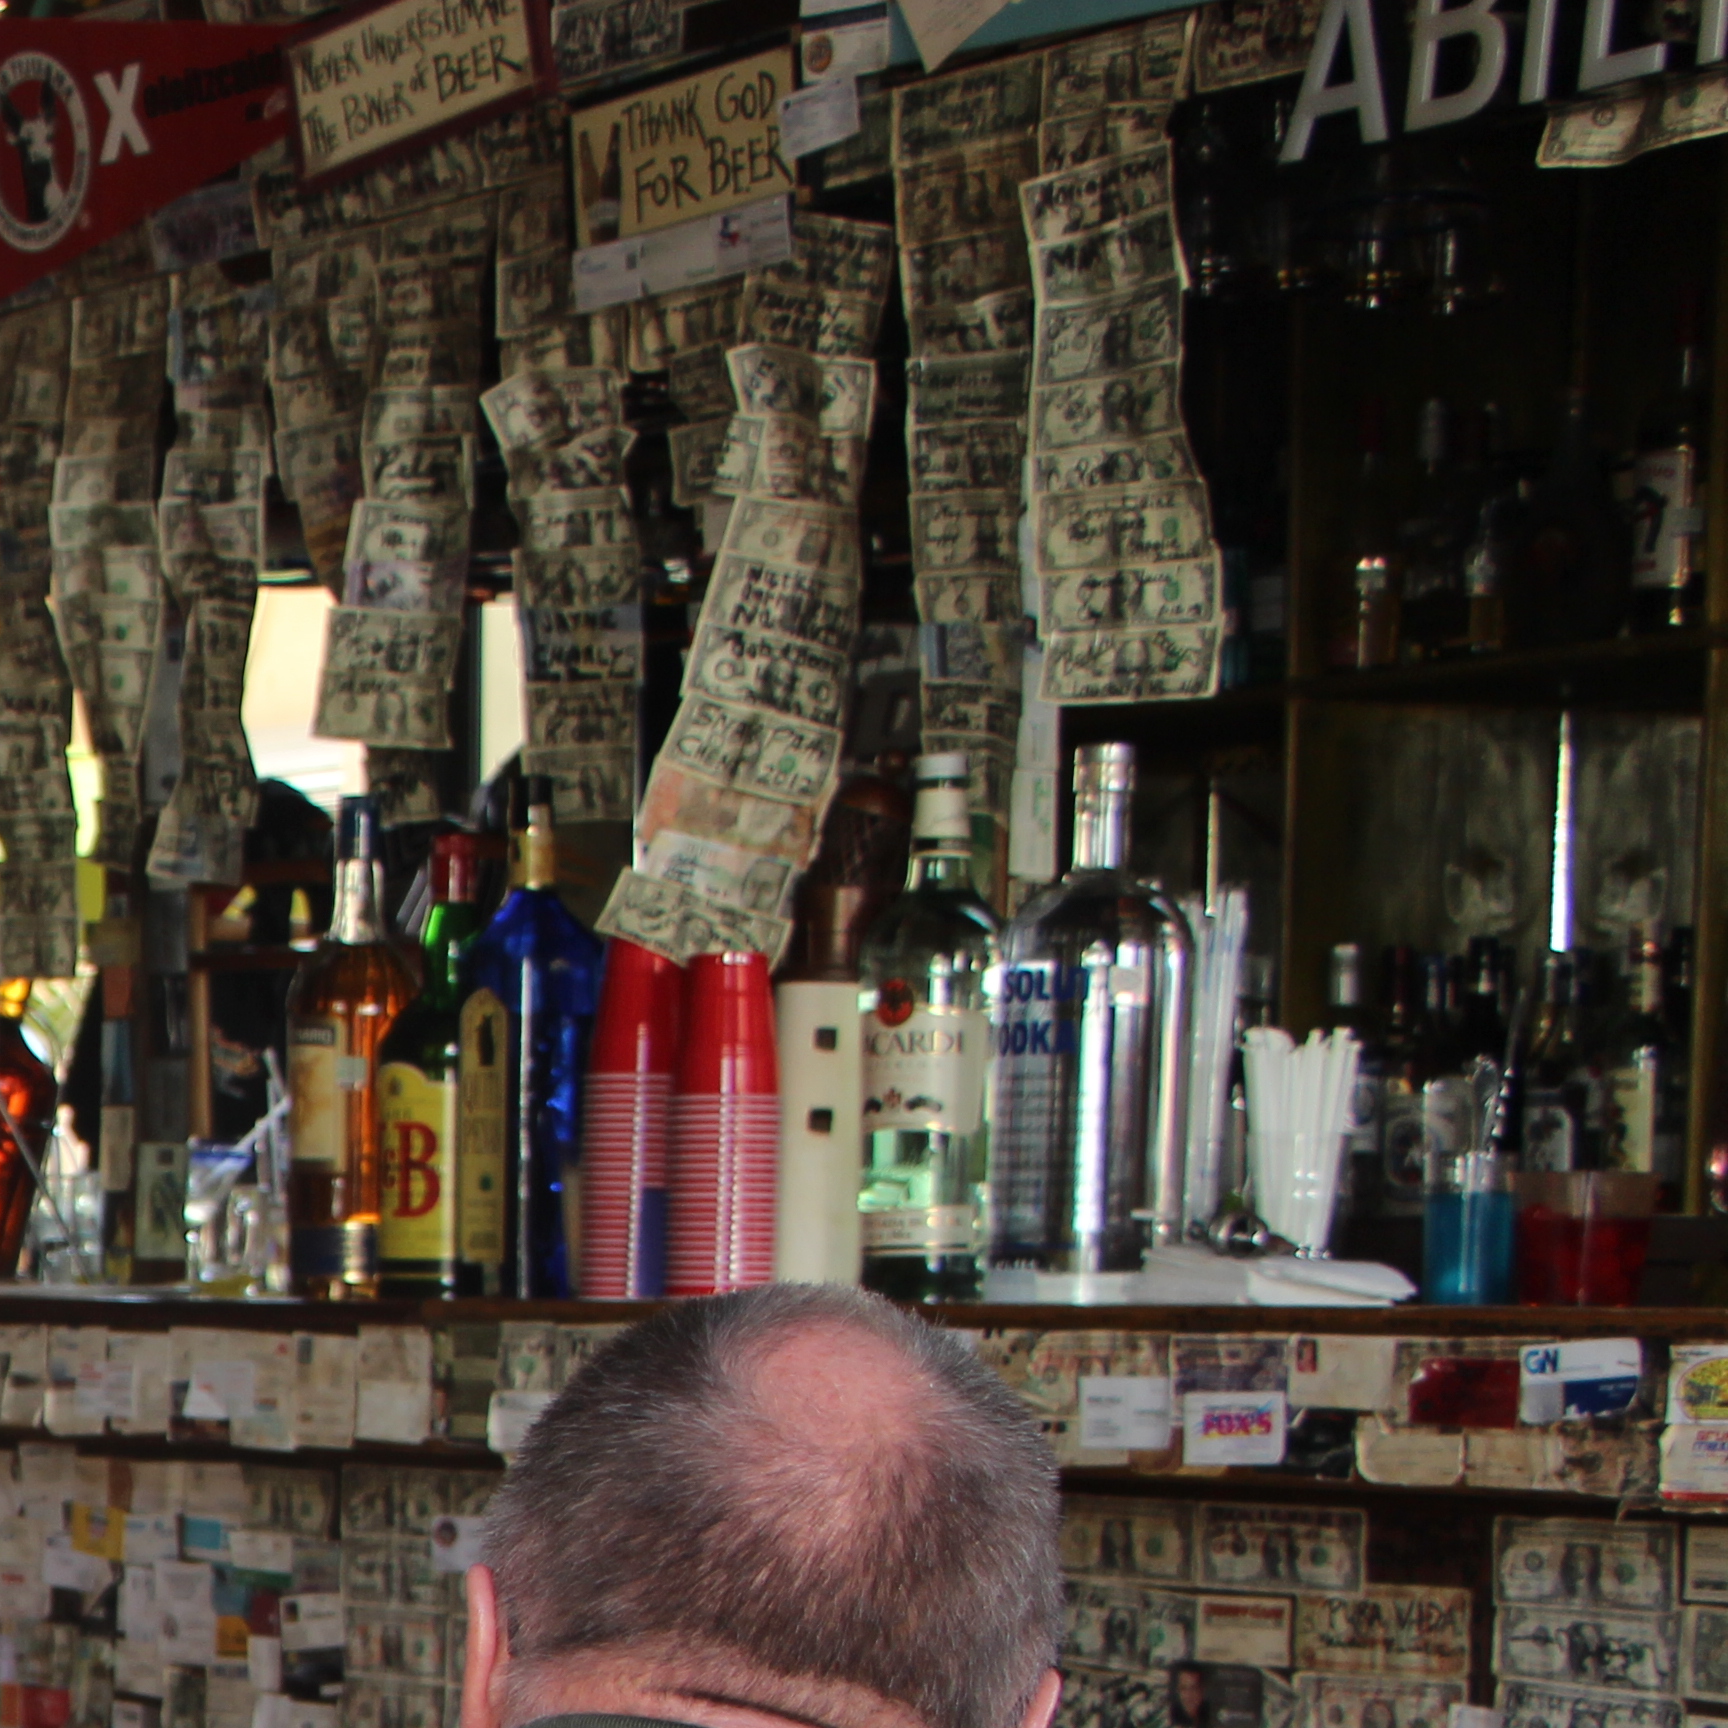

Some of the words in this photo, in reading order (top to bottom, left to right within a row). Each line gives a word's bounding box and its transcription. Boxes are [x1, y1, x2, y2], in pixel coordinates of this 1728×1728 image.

[433, 34, 523, 103] BEER
[621, 82, 707, 150] THANK
[715, 70, 778, 121] GOD
[635, 157, 701, 223] FOR
[708, 126, 794, 197] BEER
[1003, 968, 1089, 1003] SOLUT
